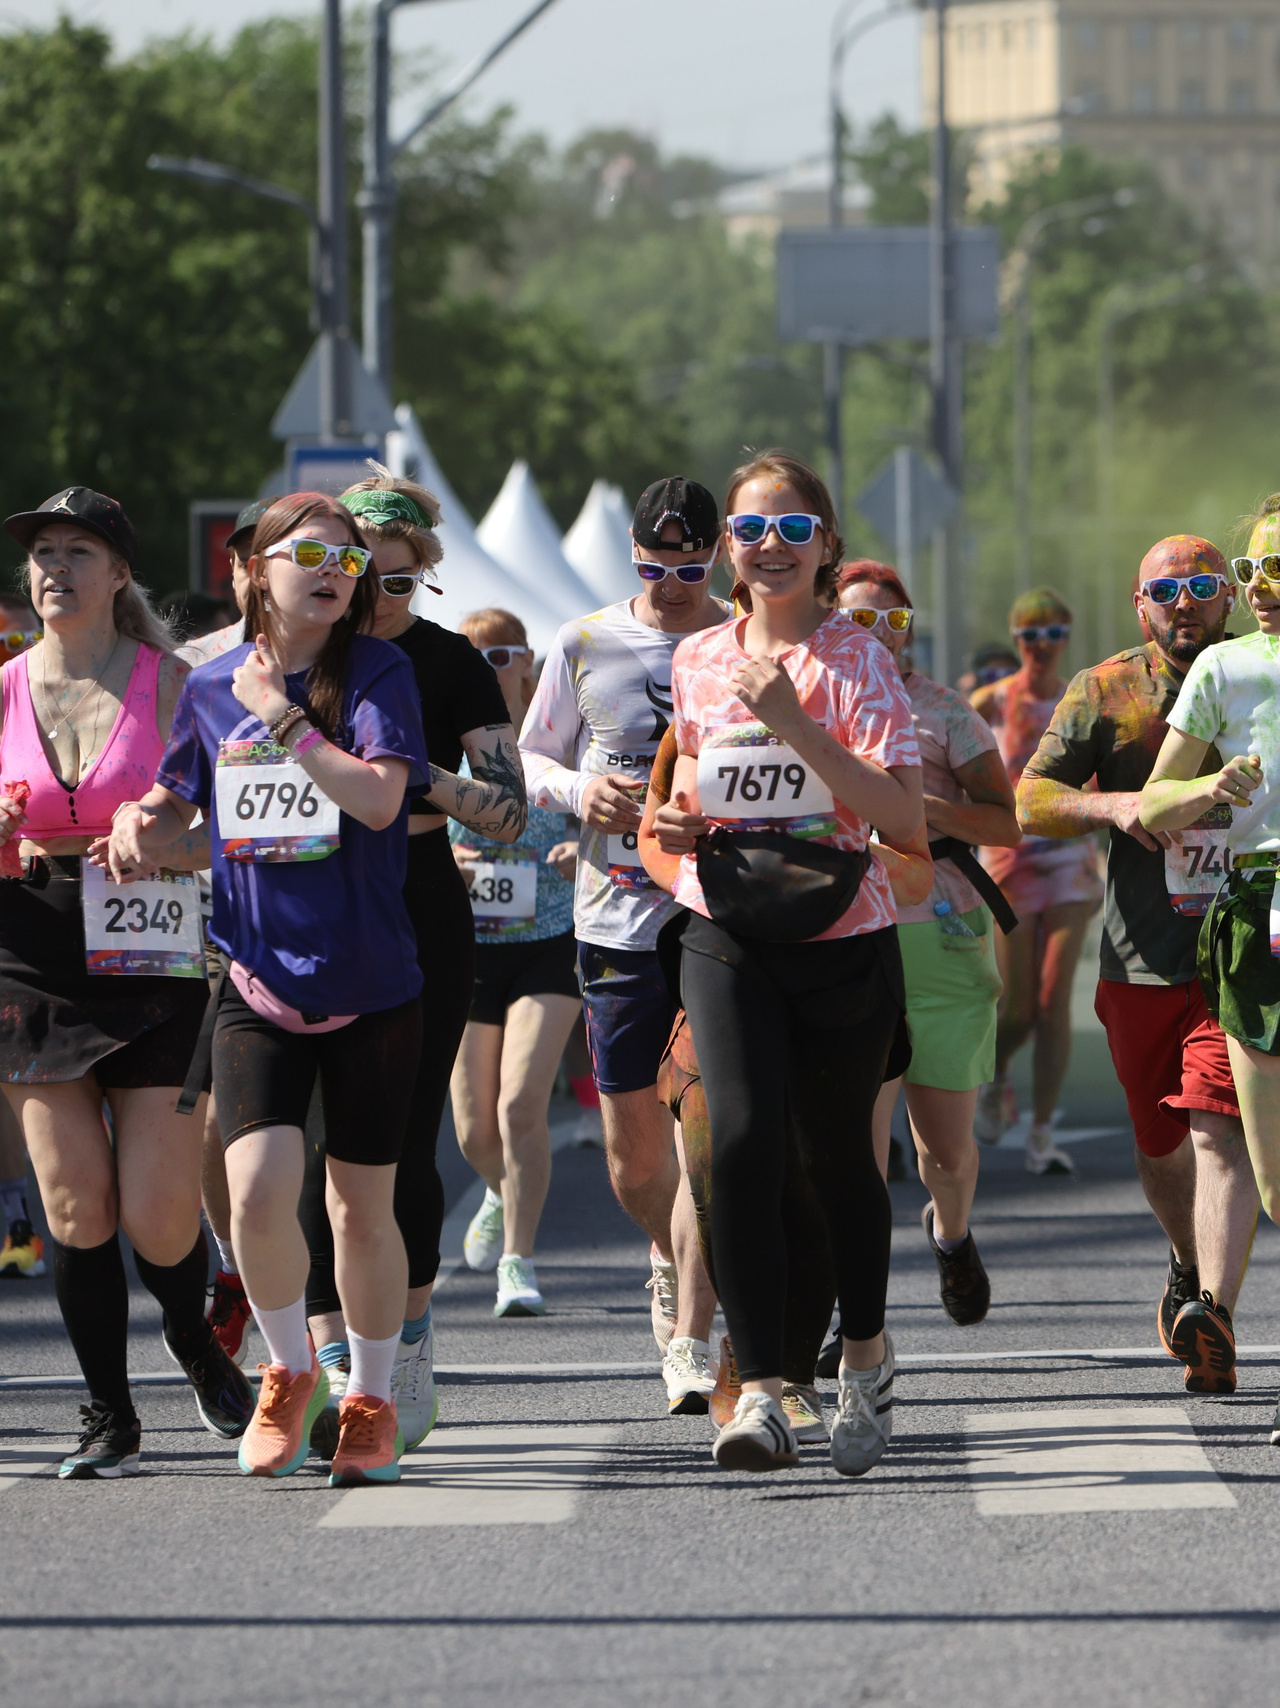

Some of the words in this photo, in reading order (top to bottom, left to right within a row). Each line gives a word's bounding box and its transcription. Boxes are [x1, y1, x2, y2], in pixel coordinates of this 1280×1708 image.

[235, 781, 319, 821] 6796
[717, 763, 806, 802] 7679
[104, 897, 183, 935] 2349
